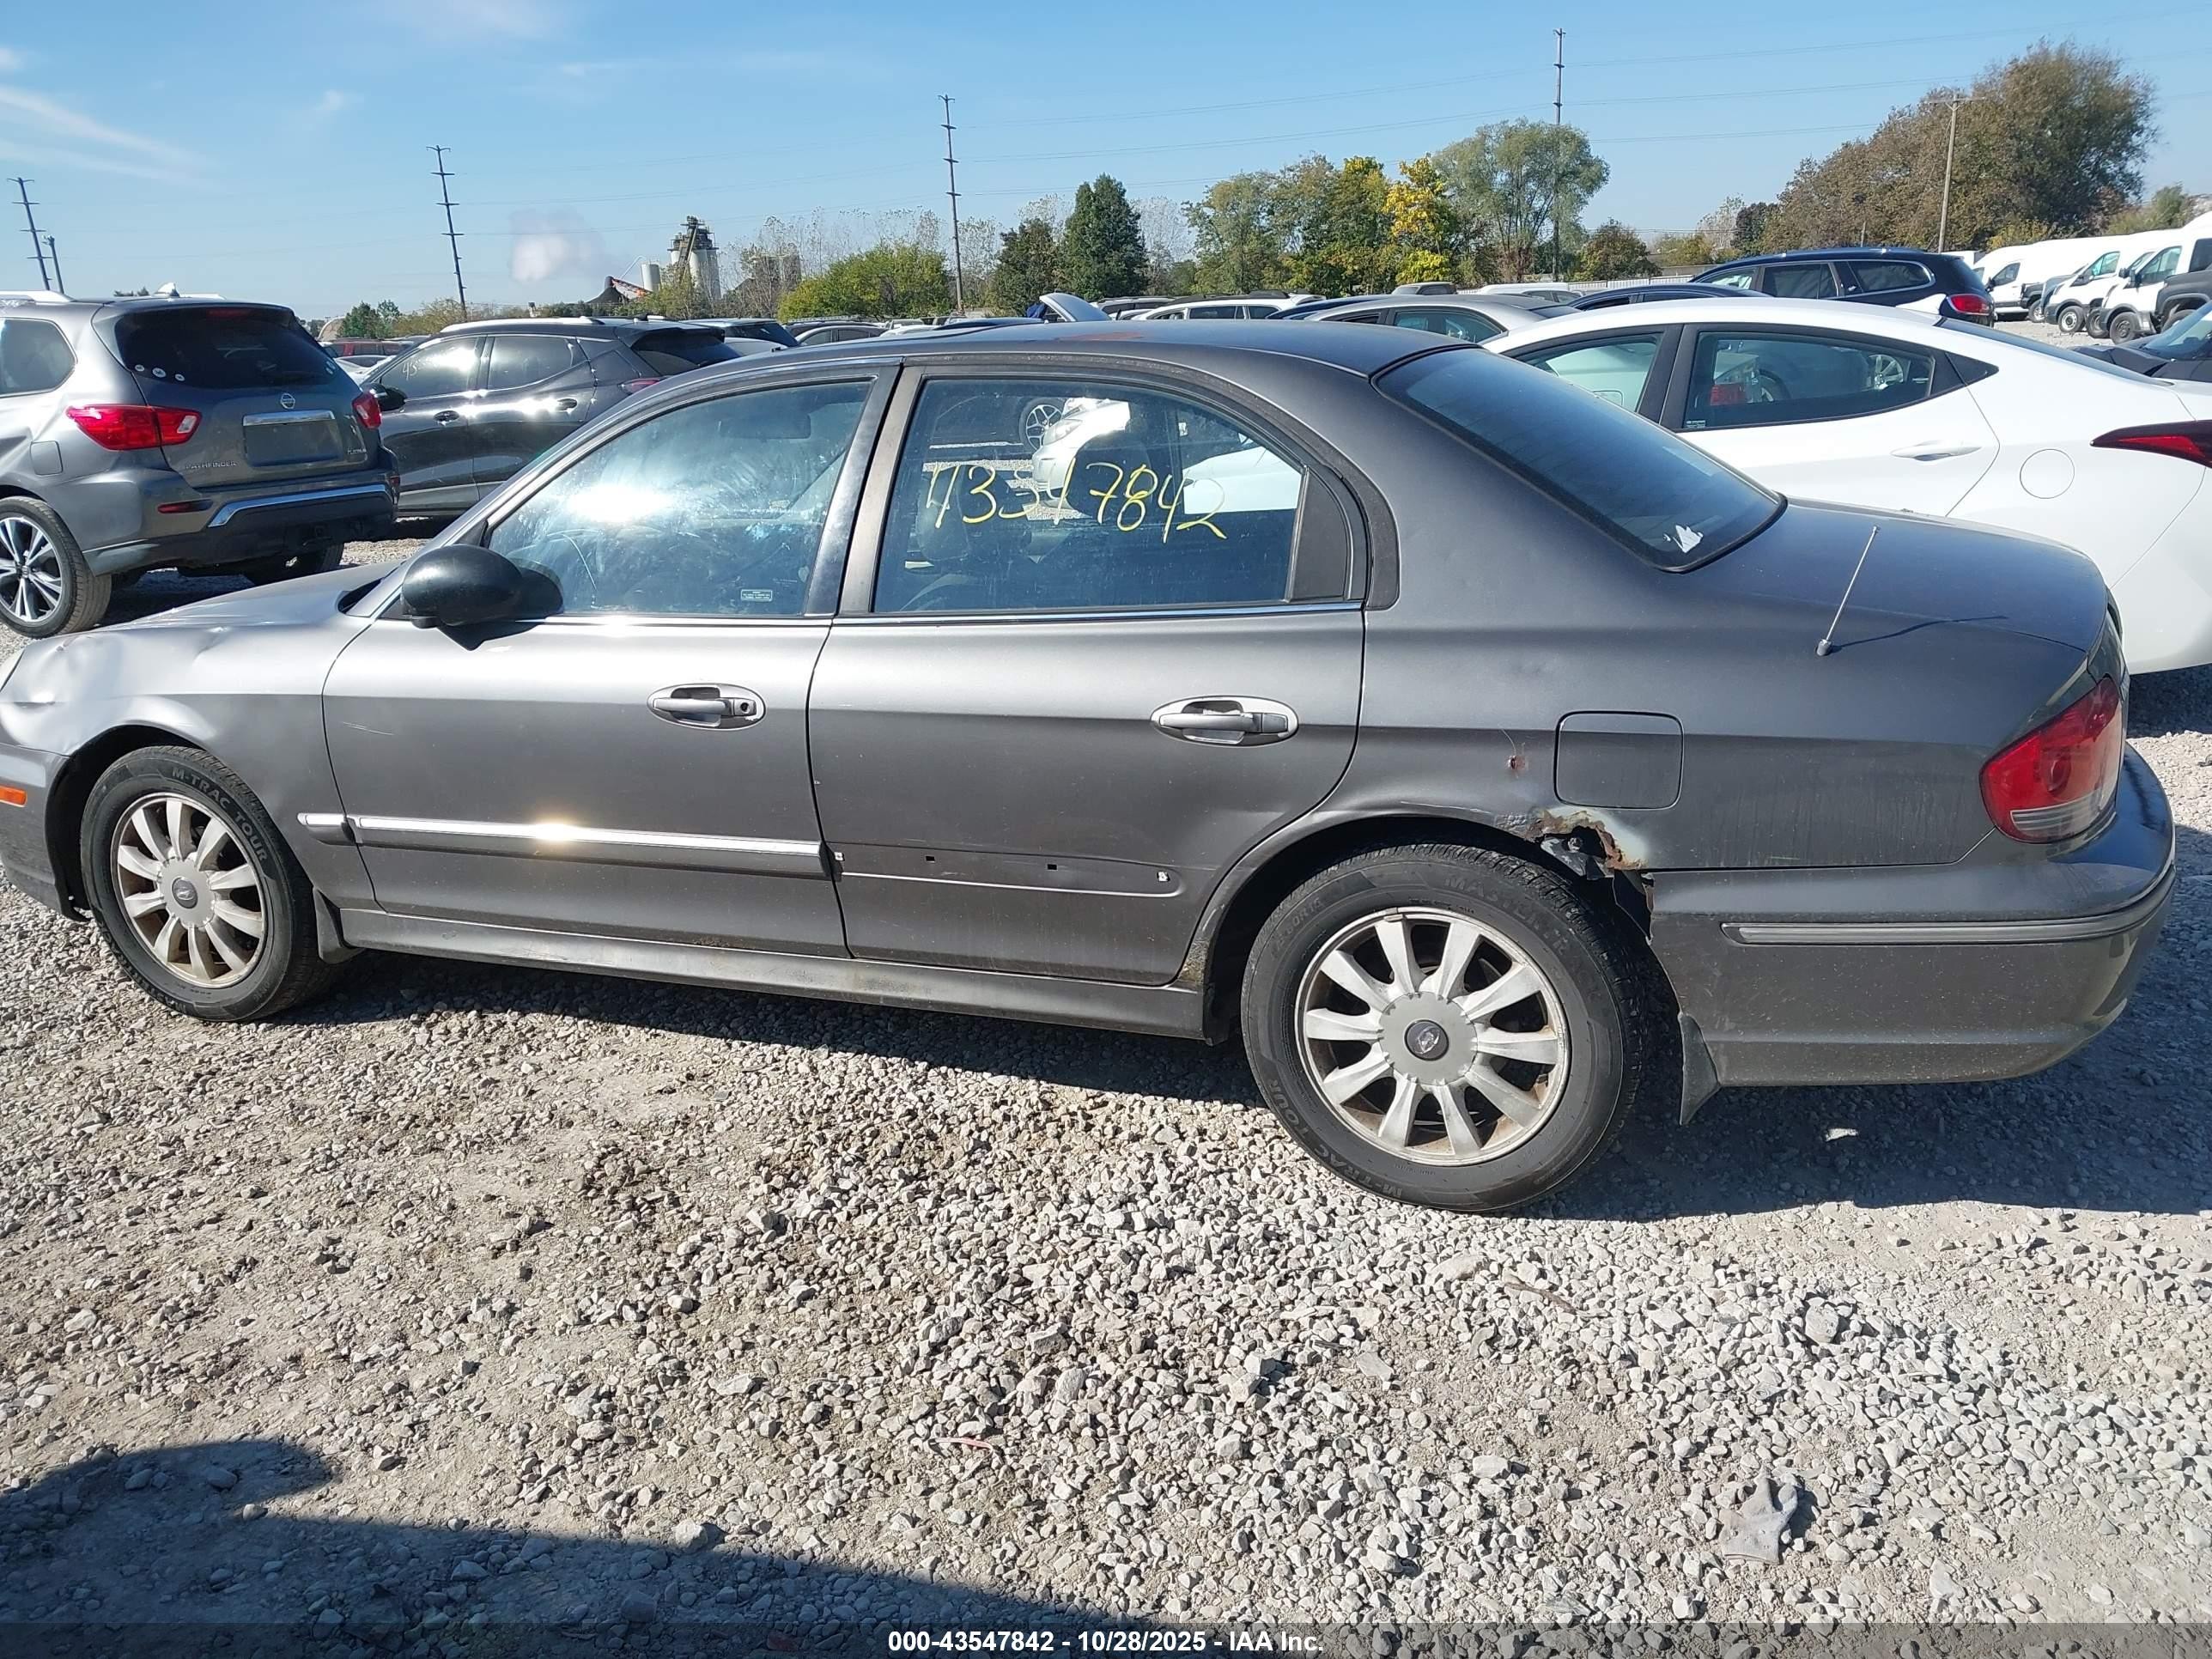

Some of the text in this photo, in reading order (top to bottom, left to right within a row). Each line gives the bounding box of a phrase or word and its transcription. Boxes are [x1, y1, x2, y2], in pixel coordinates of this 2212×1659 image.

[172, 768, 268, 861] M-TRAC TOUR
[1268, 1079, 1402, 1197] M-TRAC TOUR
